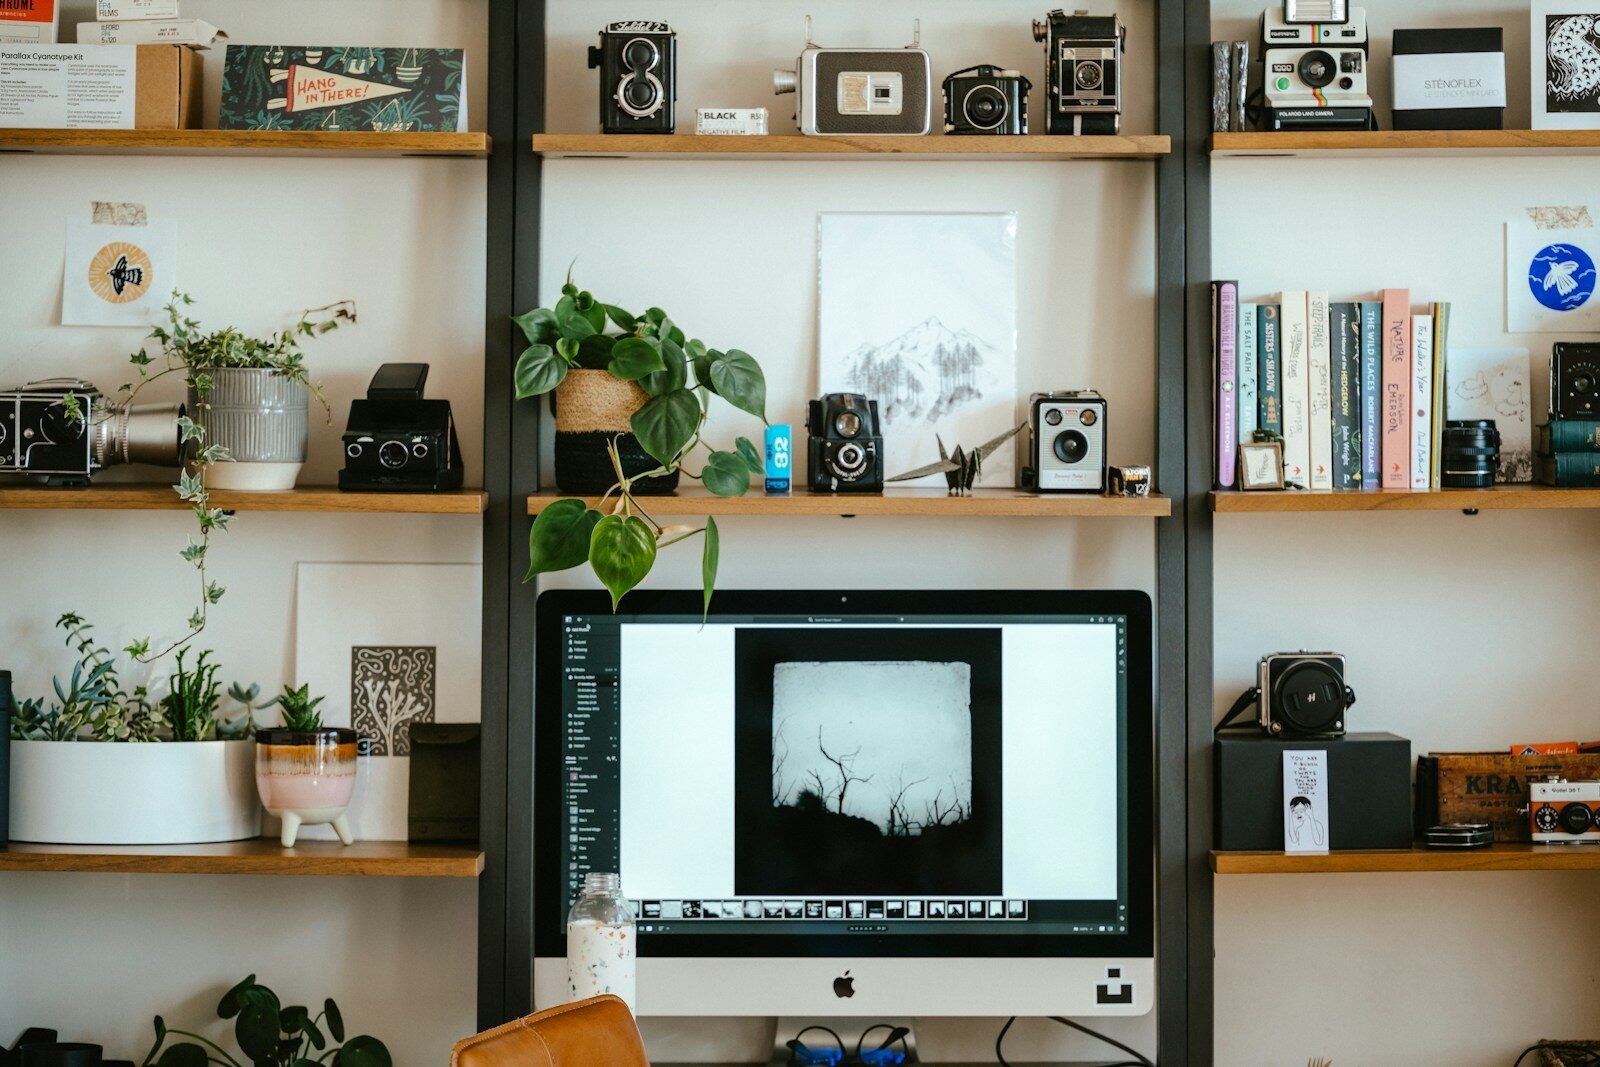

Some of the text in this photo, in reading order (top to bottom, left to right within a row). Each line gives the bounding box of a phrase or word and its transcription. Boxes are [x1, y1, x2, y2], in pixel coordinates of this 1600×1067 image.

[33, 53, 72, 61] Cyanotype
[297, 78, 336, 95] HANG
[305, 84, 369, 104] IN THERE!
[704, 112, 736, 120] BLACK
[1264, 323, 1275, 352] SISTERS
[1367, 311, 1375, 391] THE WILD PLACES
[1390, 320, 1404, 362] NATURE
[1266, 359, 1276, 392] SHADOW
[1340, 370, 1348, 416] HEDGEROW
[1367, 395, 1375, 423] ROBERT
[1388, 384, 1398, 434] EMERSON
[1341, 425, 1350, 466] John Wright
[1367, 425, 1375, 474] MACFARLANE
